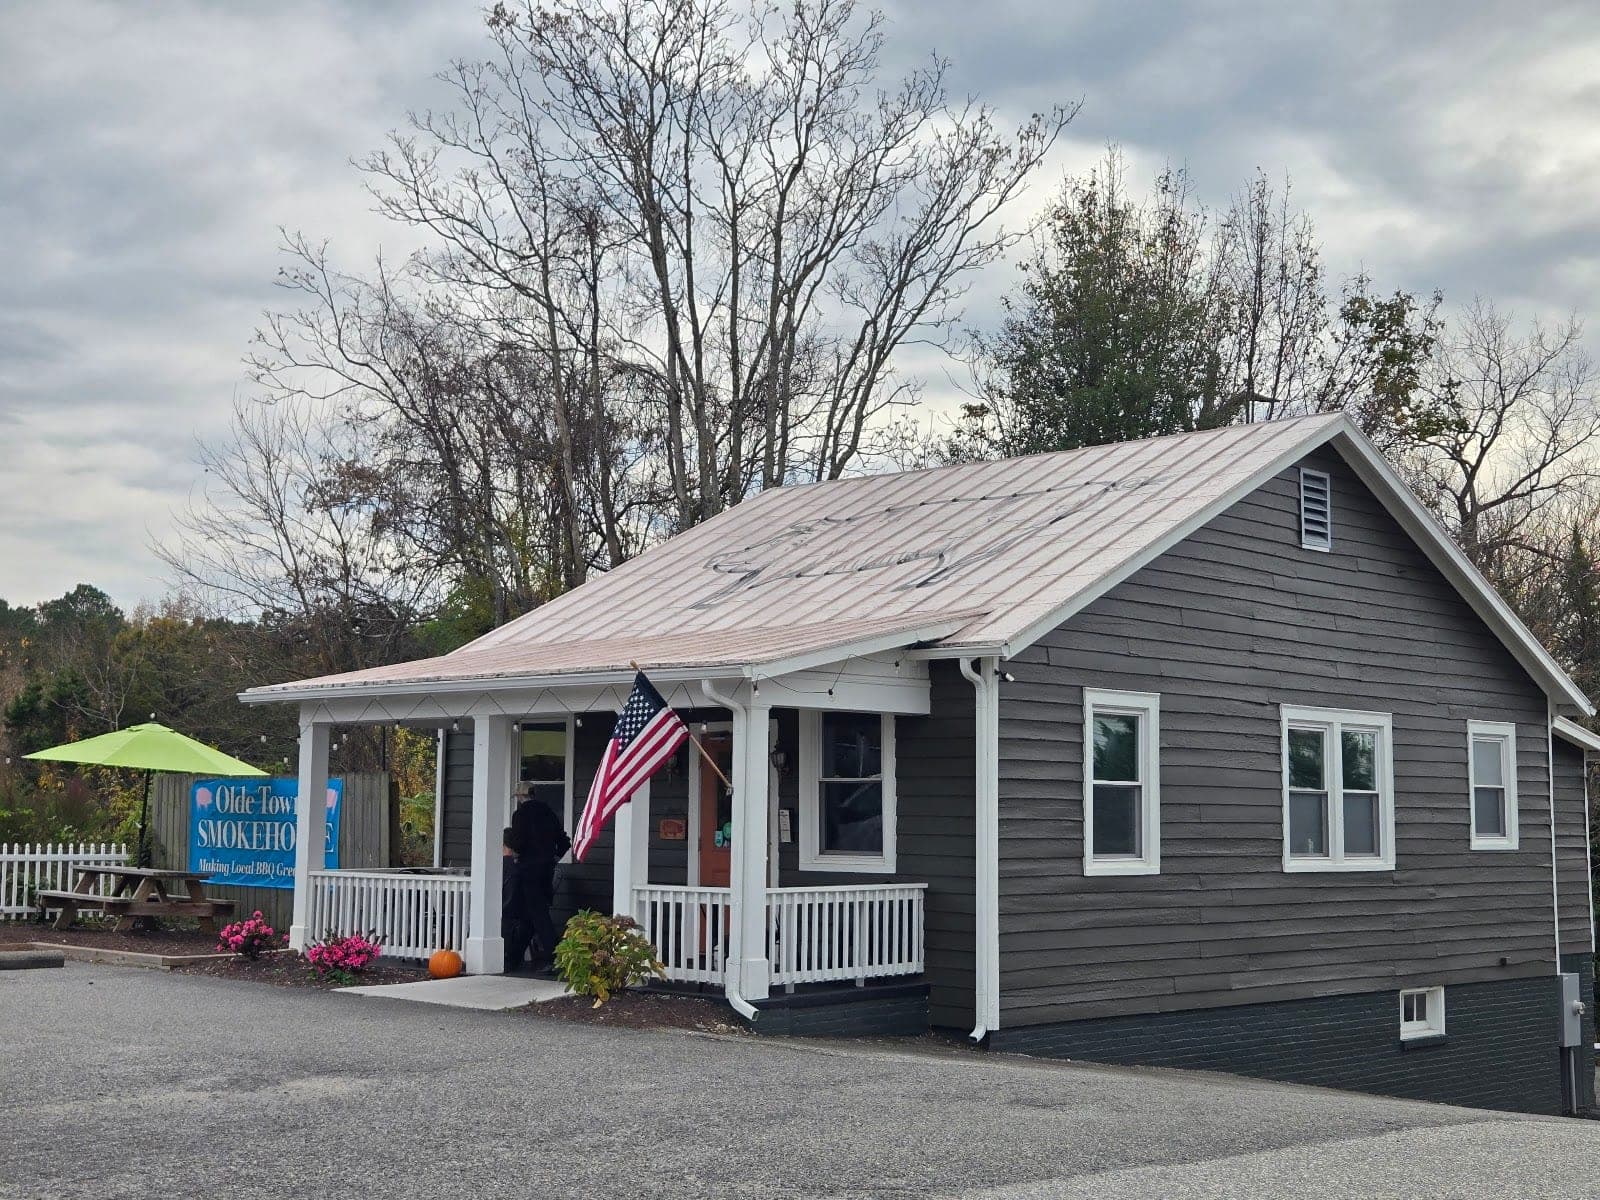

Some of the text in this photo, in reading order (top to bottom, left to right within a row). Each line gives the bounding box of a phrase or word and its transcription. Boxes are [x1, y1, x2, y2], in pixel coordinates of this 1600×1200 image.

[215, 785, 253, 815] Olde
[197, 819, 334, 853] SMOKEHOE
[199, 859, 229, 877] Making
[231, 860, 254, 875] Local
[256, 861, 275, 879] BBQ
